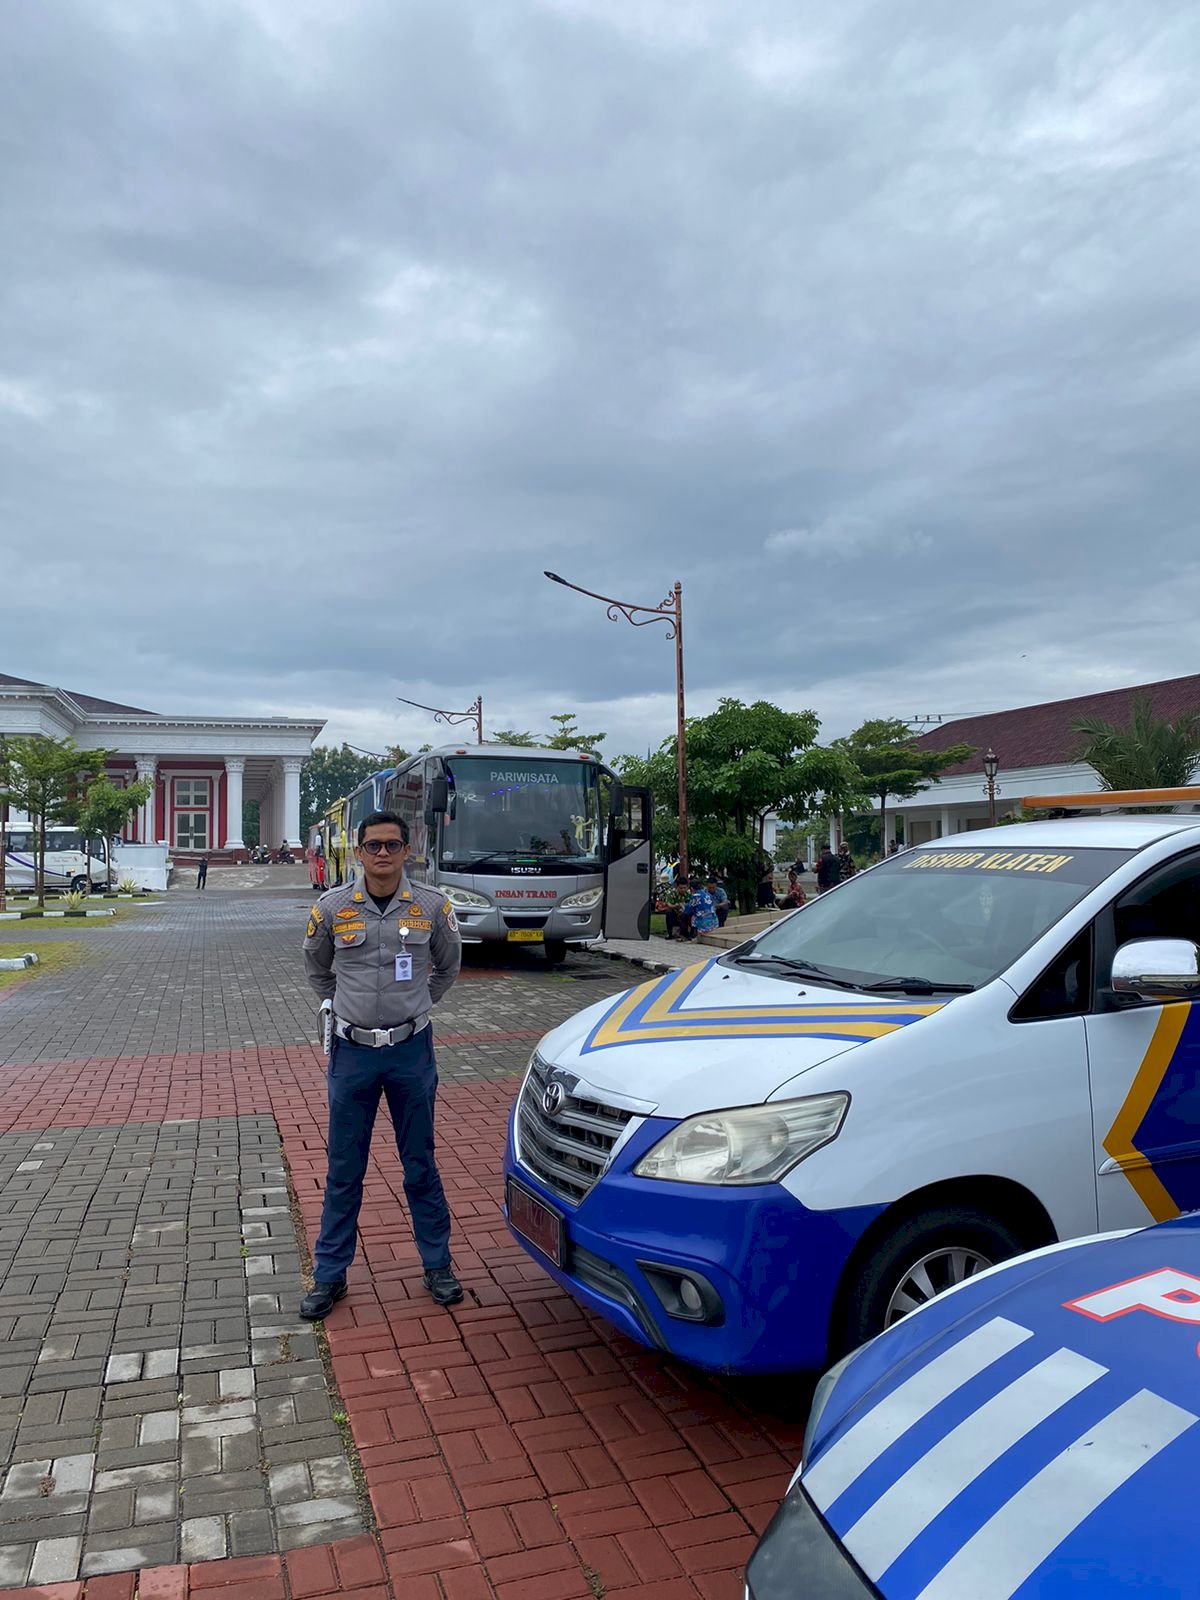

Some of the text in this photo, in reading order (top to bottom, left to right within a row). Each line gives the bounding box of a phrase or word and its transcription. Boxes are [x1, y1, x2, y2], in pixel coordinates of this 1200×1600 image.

[490, 771, 559, 784] PARIWISATA
[902, 853, 1075, 873] DISHUB KLATEN
[495, 890, 557, 898] INSAN TRANS
